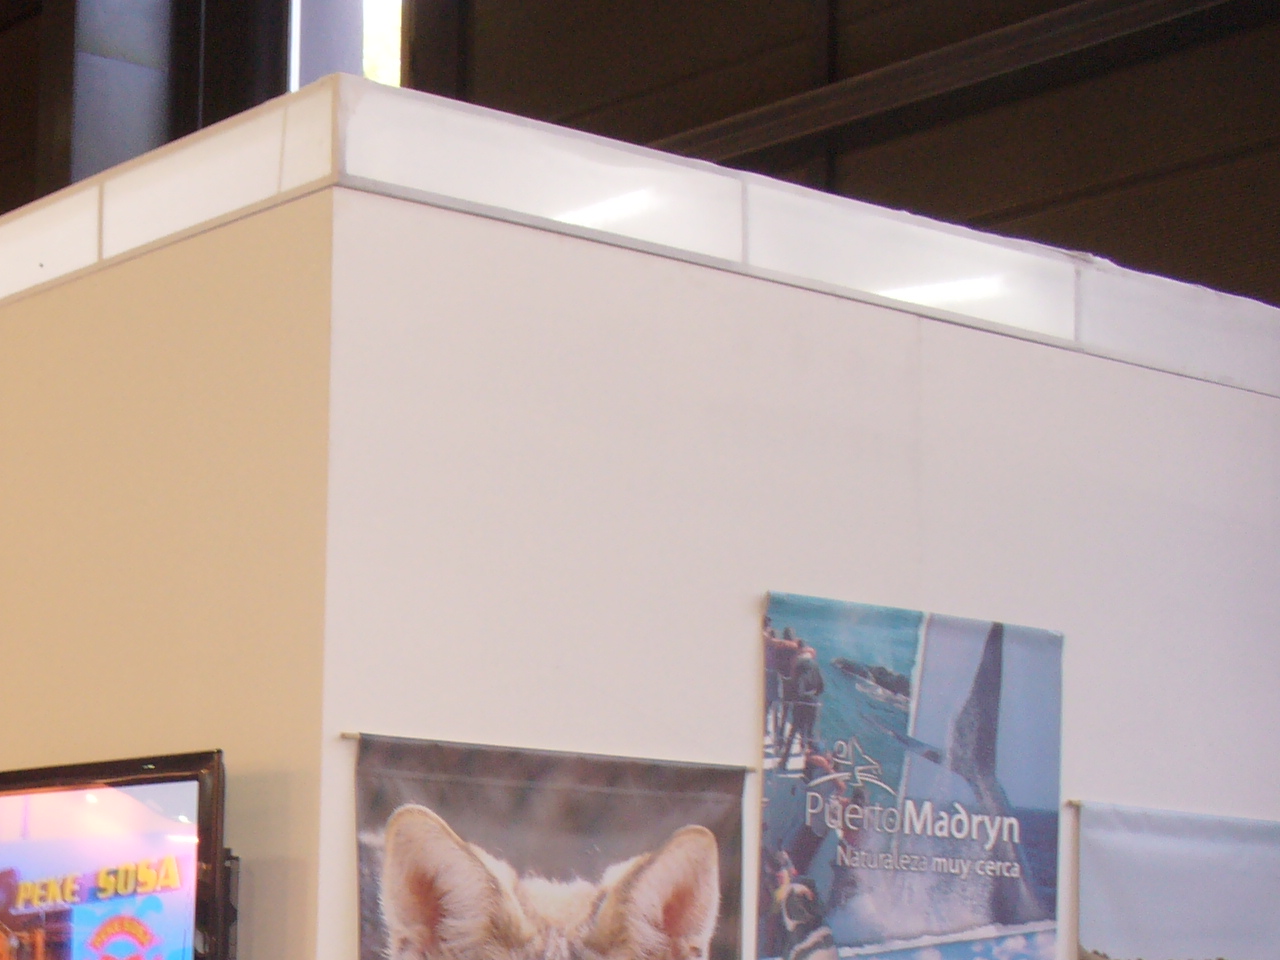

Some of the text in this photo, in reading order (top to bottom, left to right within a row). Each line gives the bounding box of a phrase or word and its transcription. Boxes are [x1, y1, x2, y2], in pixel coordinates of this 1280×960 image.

[14, 854, 181, 909] PEKE SOSA
[836, 844, 1021, 880] Naturaleza muy cerca
